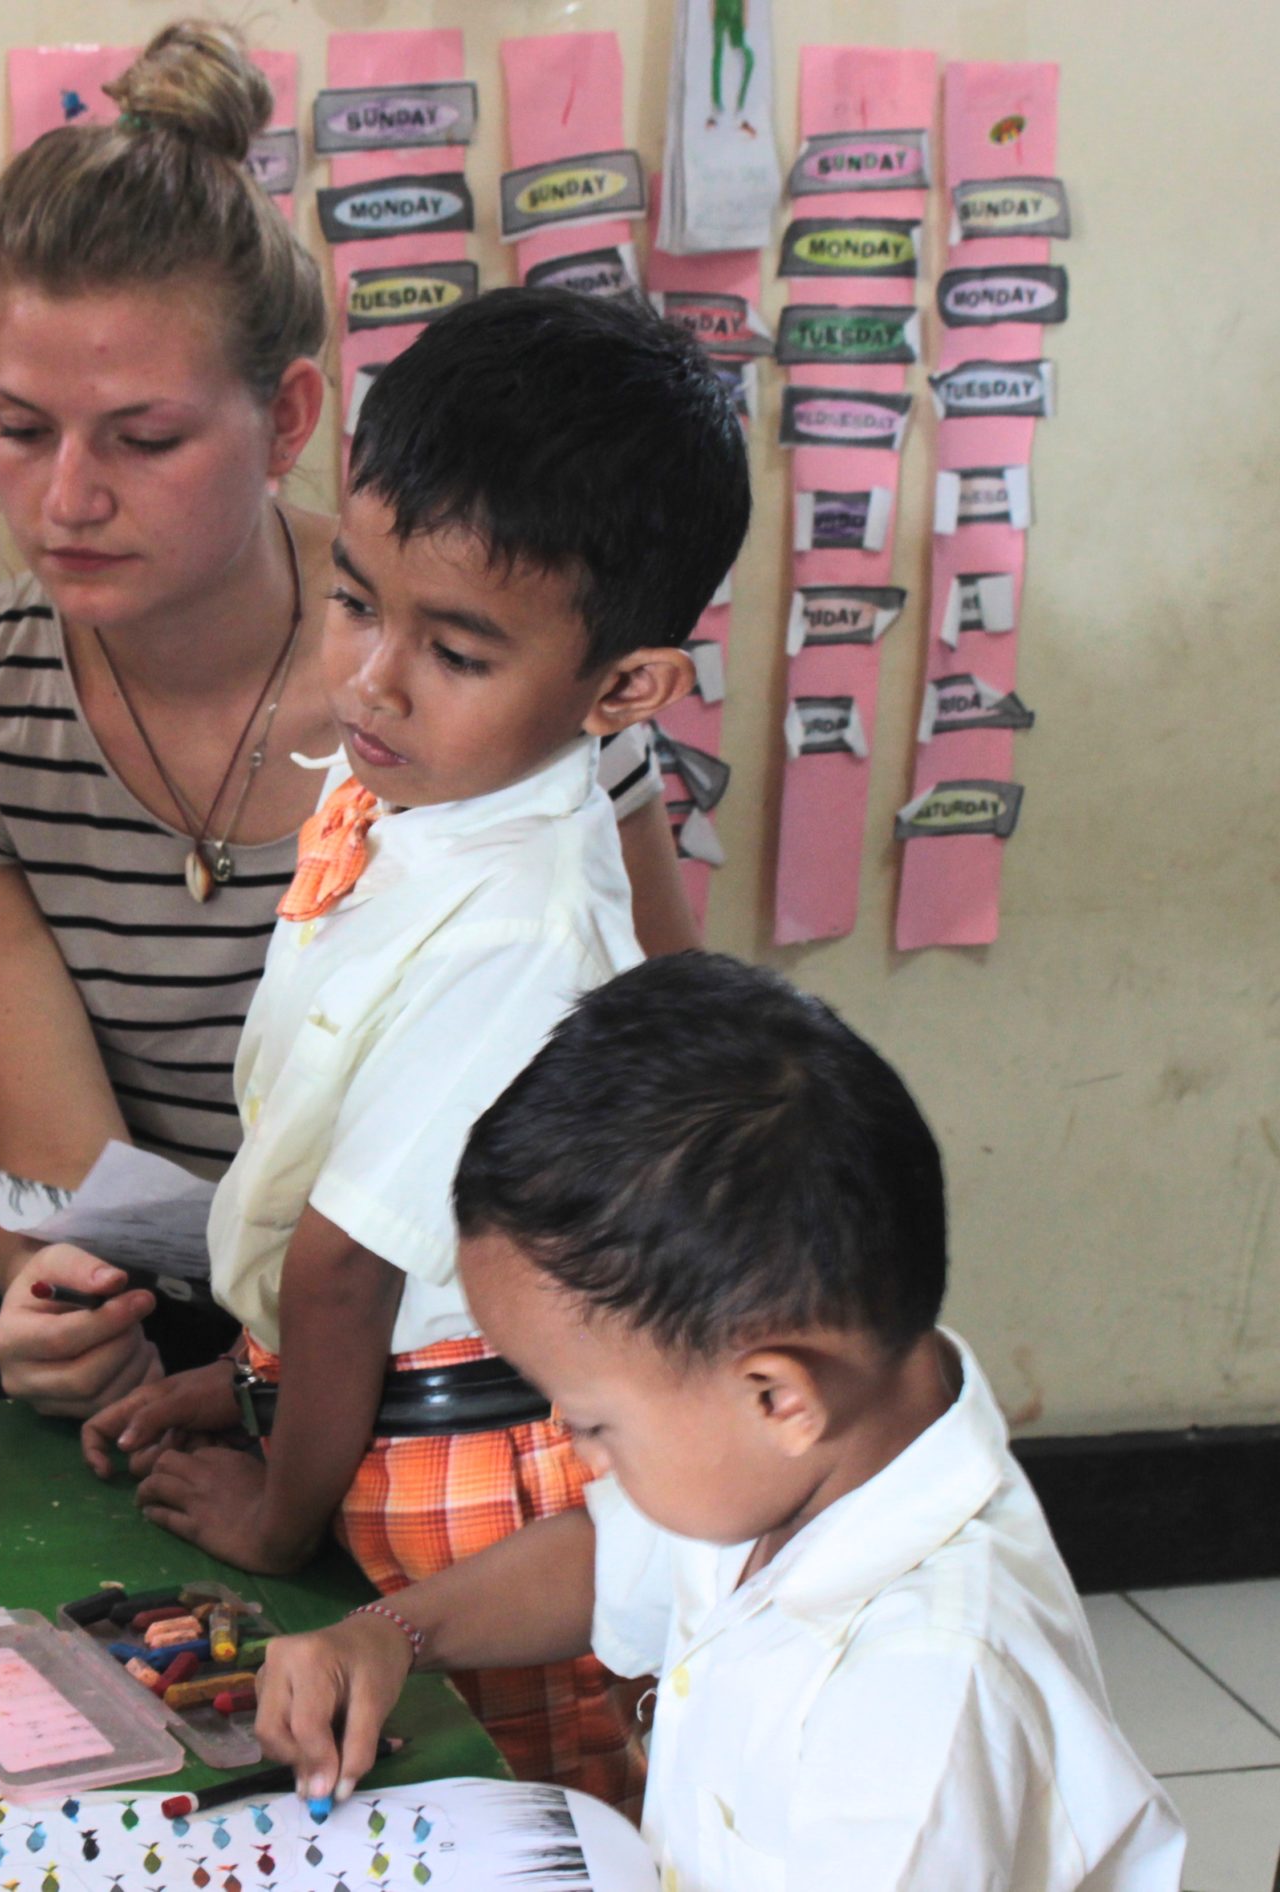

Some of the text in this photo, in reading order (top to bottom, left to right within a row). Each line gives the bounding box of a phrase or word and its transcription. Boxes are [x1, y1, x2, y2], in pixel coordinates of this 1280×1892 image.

[346, 106, 438, 132] SUNDAY
[817, 151, 907, 176] SUNDAY
[527, 174, 606, 209] SUNDAY
[349, 196, 443, 221] MONDAY
[960, 200, 1043, 223] SUNDAY
[808, 239, 905, 261] MONDAY
[351, 285, 446, 312] TUESDAY
[953, 289, 1037, 309] MONDAY
[797, 322, 901, 349] TUESDAY
[944, 378, 1035, 401] TUESDAY
[795, 410, 898, 432] WEDNESDAY
